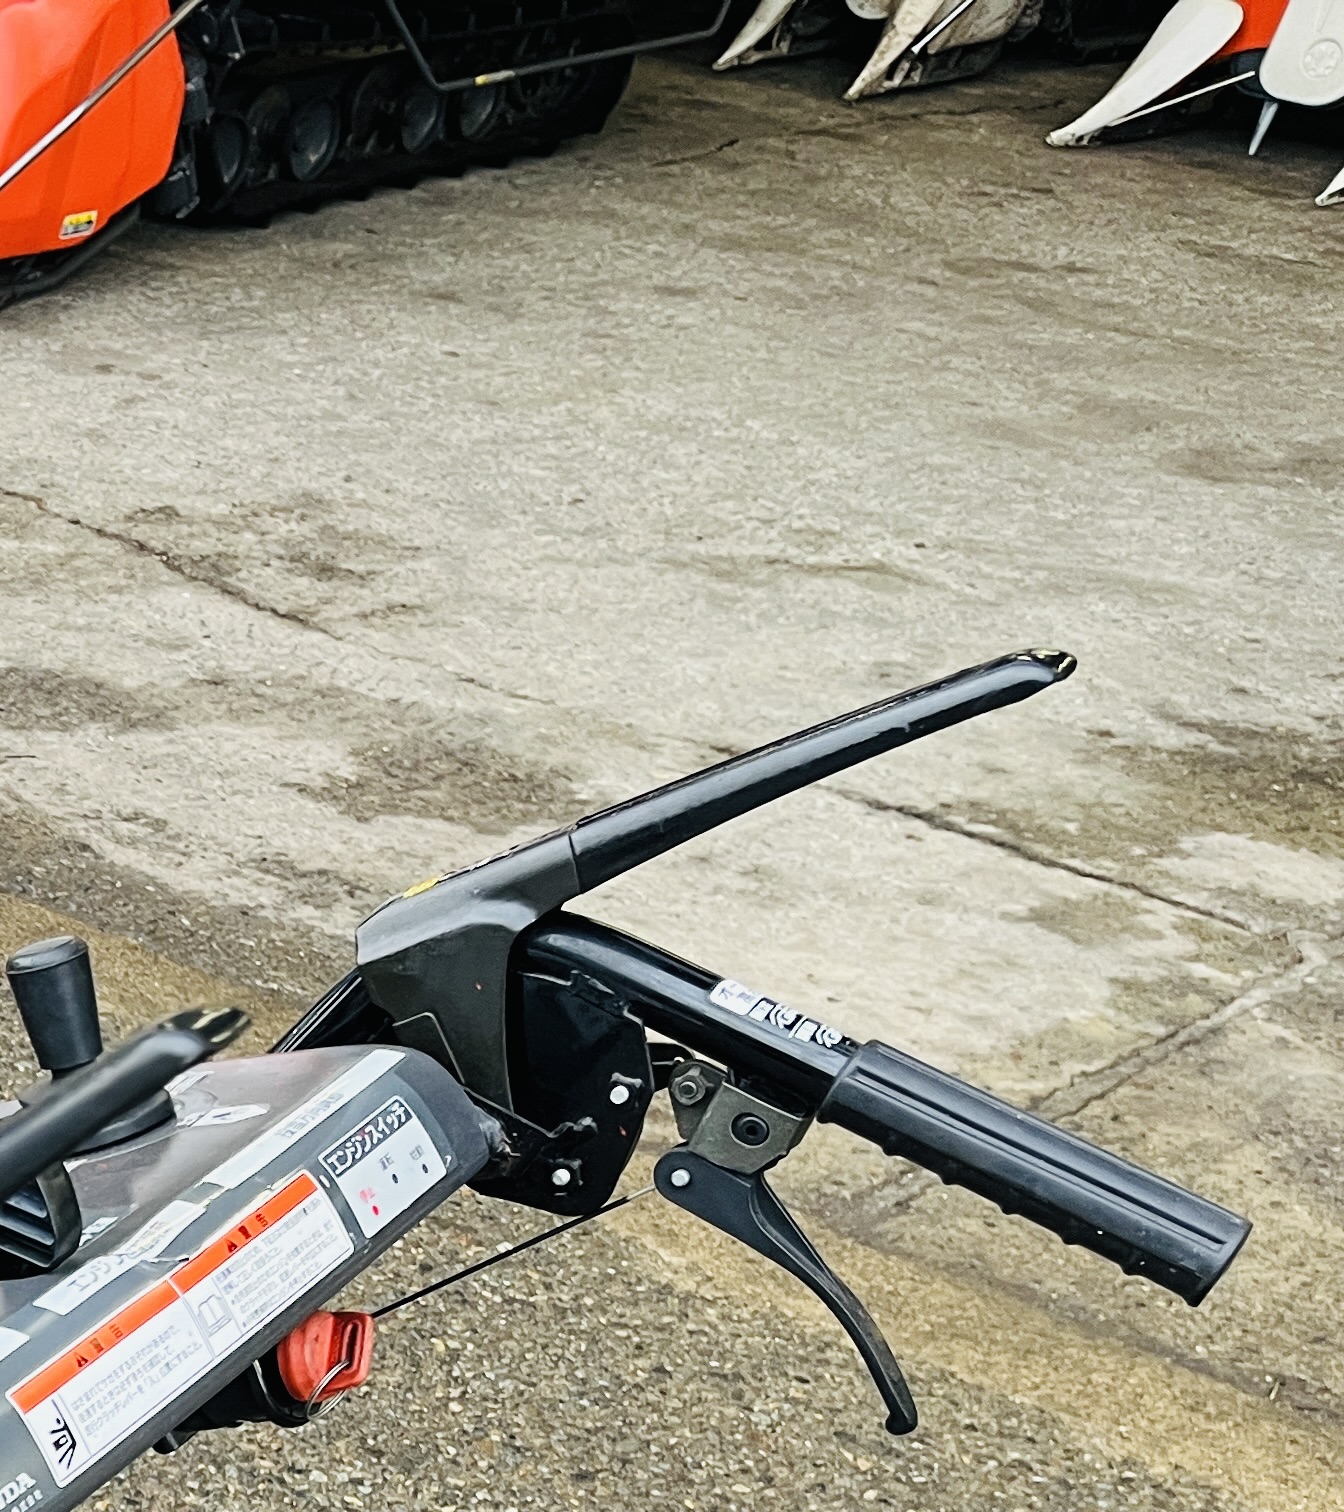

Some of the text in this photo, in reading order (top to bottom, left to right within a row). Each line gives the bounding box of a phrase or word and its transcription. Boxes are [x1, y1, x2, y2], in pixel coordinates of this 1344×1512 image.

[326, 1101, 406, 1176] エンジンスイッチ
